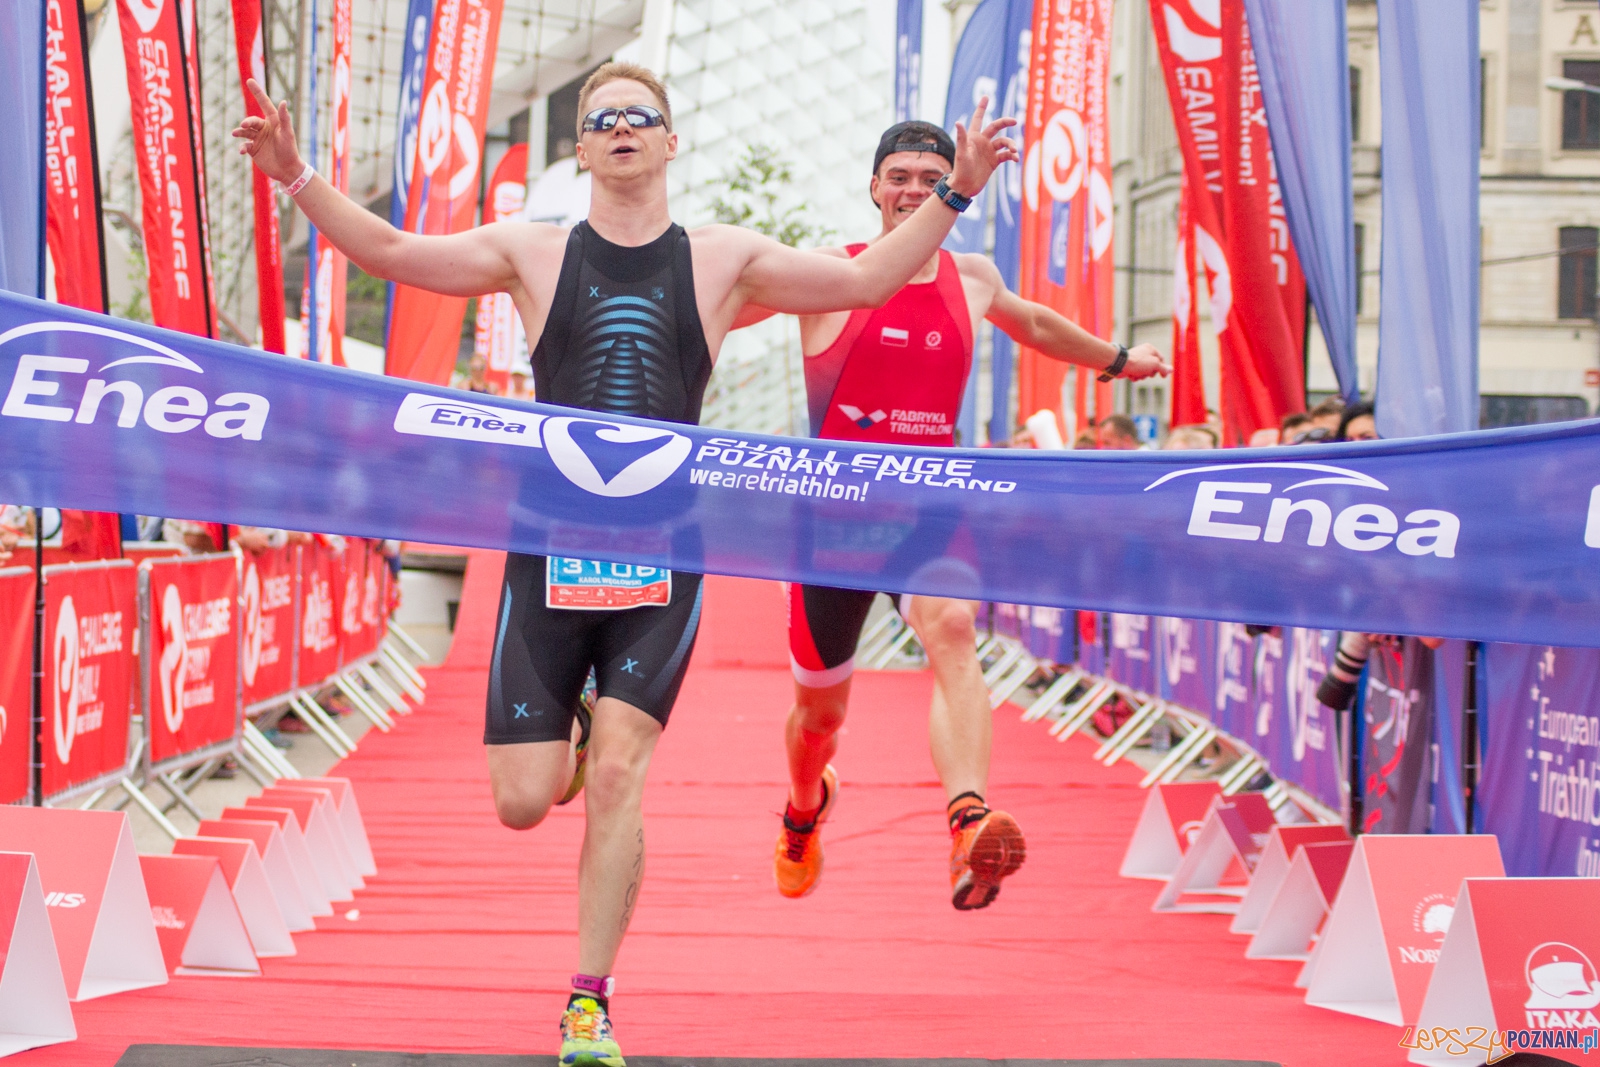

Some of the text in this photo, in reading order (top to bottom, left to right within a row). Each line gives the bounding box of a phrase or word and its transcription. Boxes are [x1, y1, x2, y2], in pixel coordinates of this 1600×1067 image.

[1, 354, 270, 441] Enea
[430, 408, 527, 434] Enea
[890, 409, 946, 424] FABRYKA
[706, 438, 977, 477] CHALLENGE
[689, 467, 870, 502] wearetriathlon!
[874, 468, 1017, 493] POLAND
[1187, 481, 1461, 558] Enea
[578, 576, 601, 584] KAROL
[1538, 750, 1600, 826] Triathlo
[1398, 946, 1440, 964] NOB
[1525, 1010, 1600, 1029] ITAKA
